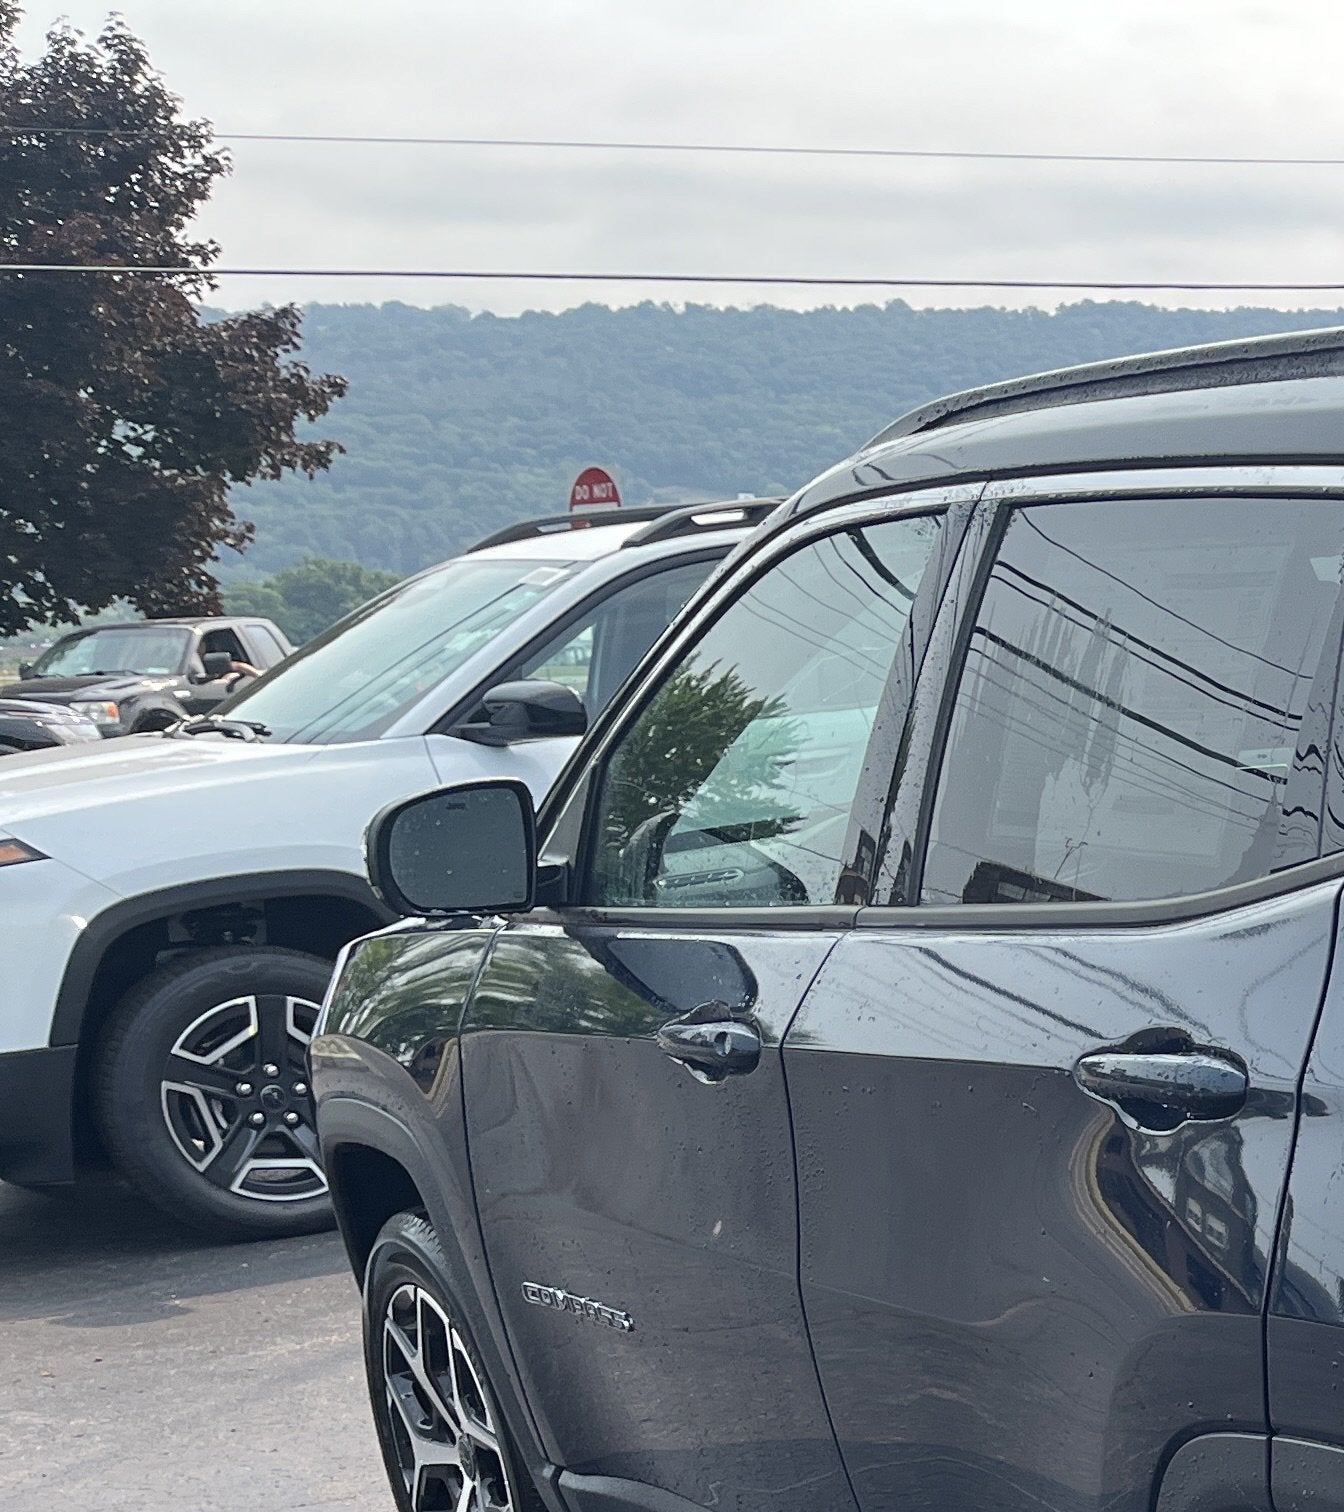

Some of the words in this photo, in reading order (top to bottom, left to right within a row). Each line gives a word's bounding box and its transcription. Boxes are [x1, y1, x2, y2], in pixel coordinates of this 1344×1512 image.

[575, 484, 590, 500] DO
[594, 482, 613, 498] NOT
[520, 1280, 635, 1333] COMPASS
